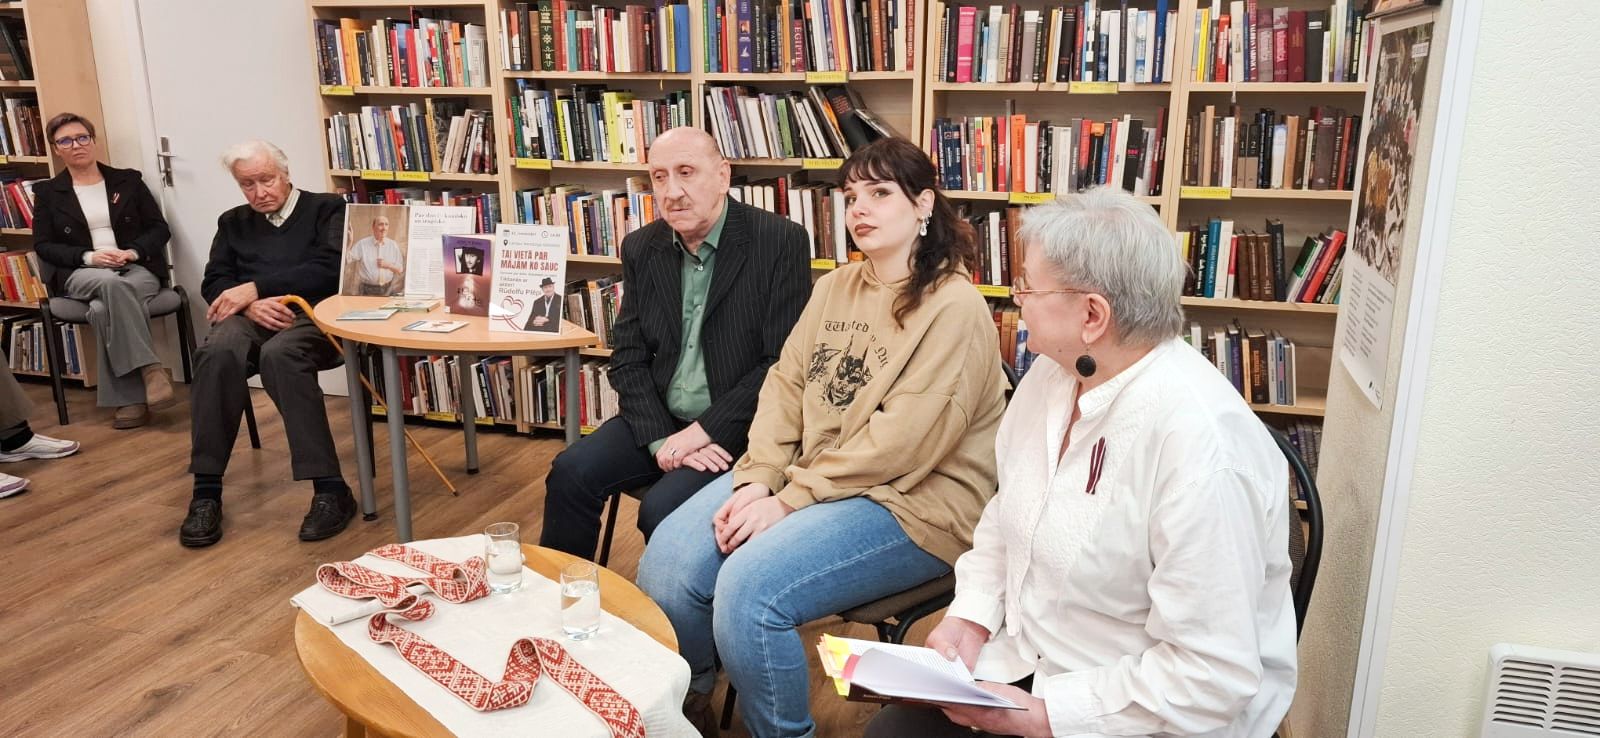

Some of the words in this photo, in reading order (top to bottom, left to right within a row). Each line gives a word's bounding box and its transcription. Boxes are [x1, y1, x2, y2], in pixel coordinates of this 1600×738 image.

[794, 26, 803, 62] EGIPTE
[502, 249, 512, 258] TAI
[535, 251, 548, 260] PAR
[530, 262, 539, 270] KO
[541, 262, 559, 271] SAUC
